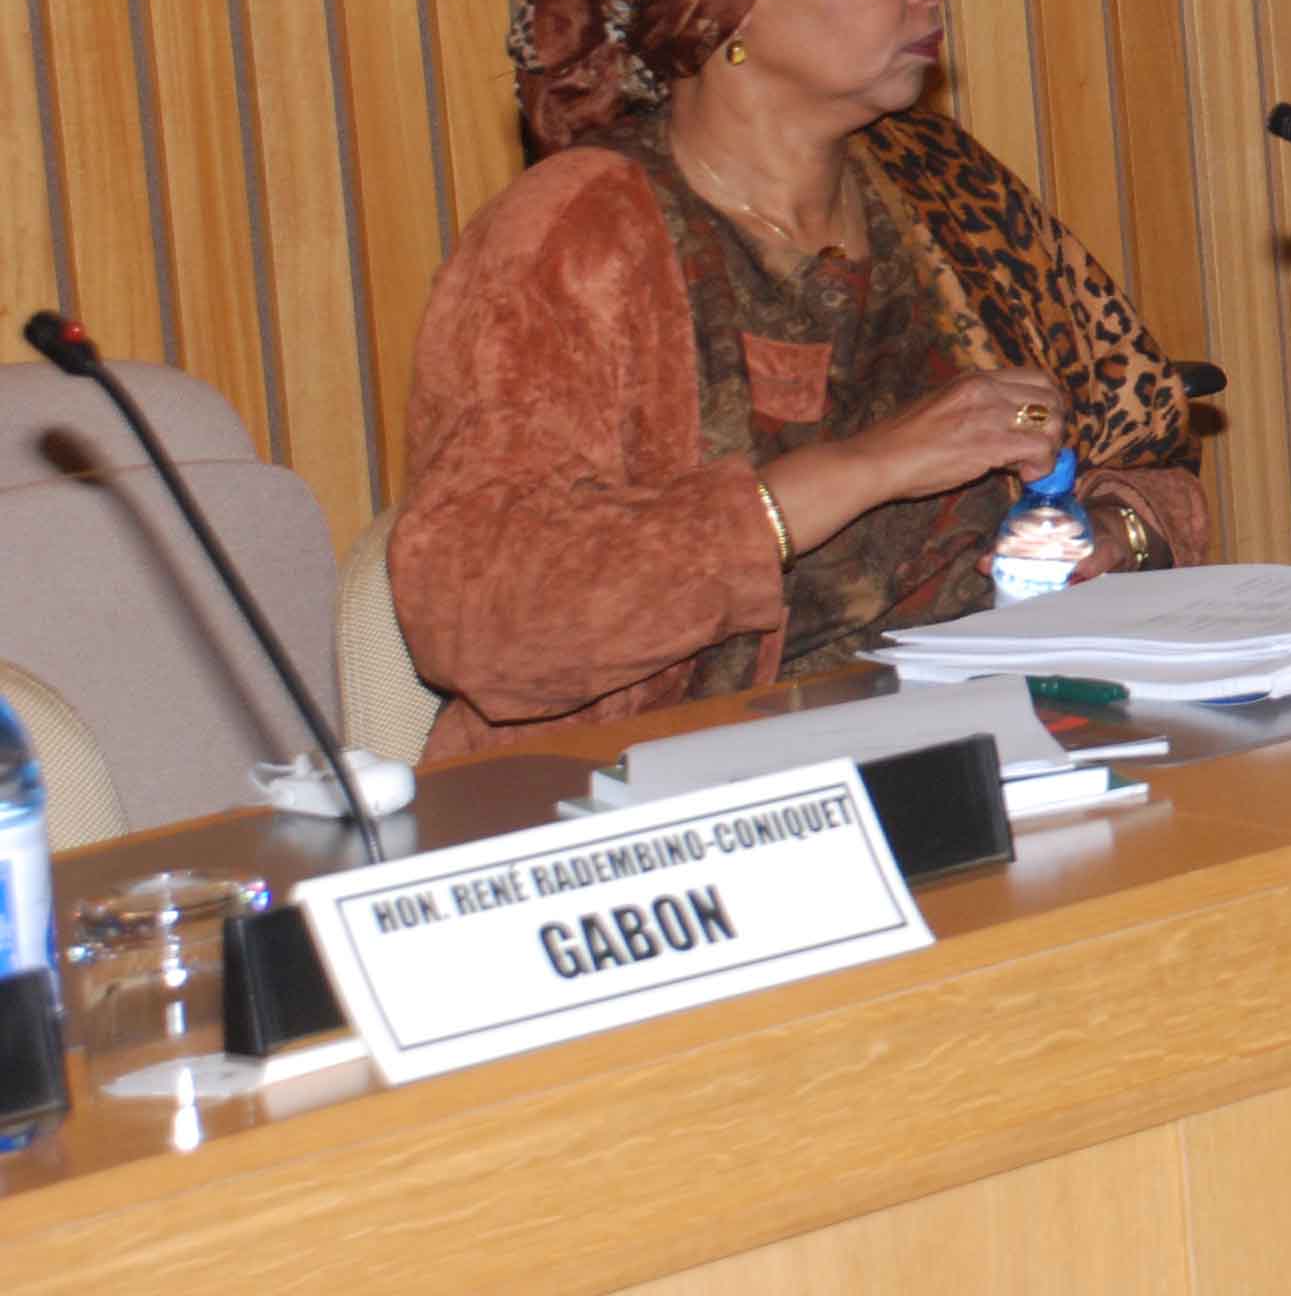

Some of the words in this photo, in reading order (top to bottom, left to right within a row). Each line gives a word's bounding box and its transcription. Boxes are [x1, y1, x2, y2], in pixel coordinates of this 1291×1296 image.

[372, 892, 450, 934] HON.
[451, 864, 533, 917] RENÉ
[531, 797, 854, 898] RADEMBINO-CONIQUET
[538, 883, 738, 980] GABON
